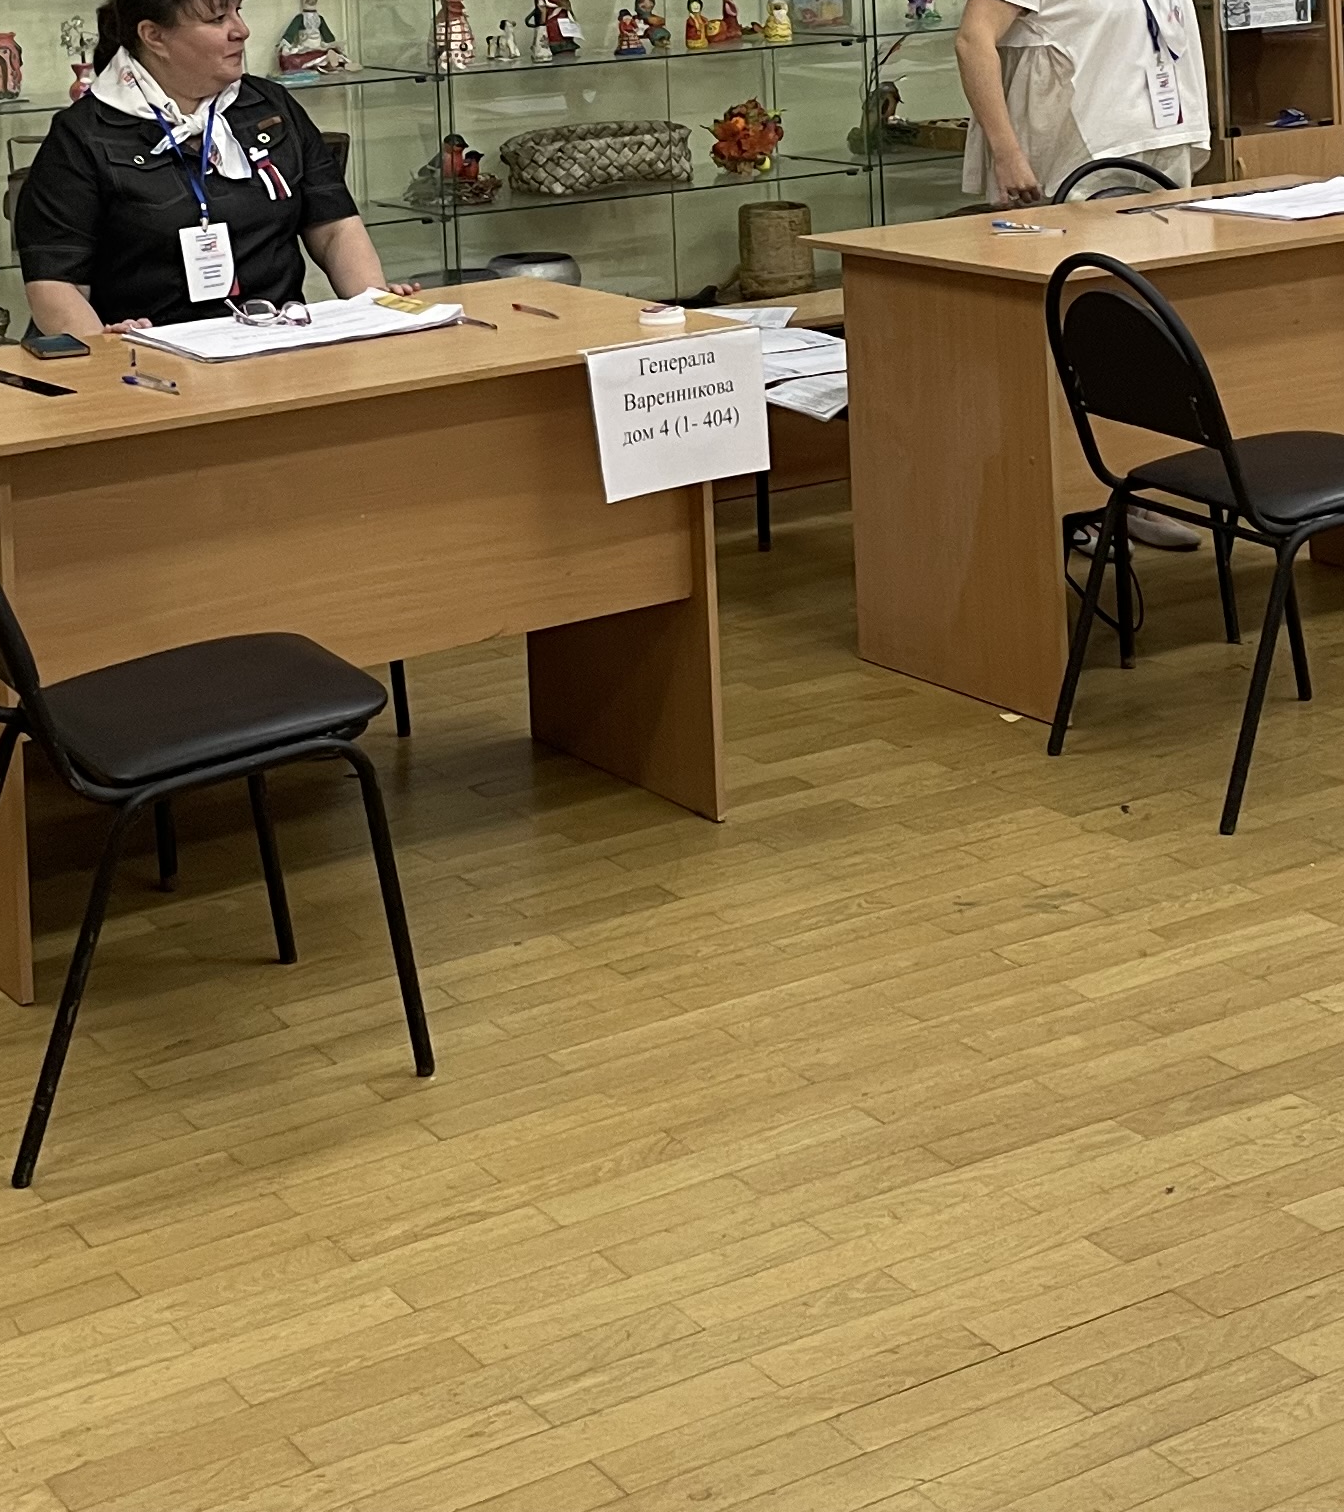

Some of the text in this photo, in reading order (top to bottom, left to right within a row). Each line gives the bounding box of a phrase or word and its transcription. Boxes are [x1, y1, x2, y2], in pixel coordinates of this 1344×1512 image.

[638, 351, 716, 377] Генерала
[623, 379, 735, 413] Варенникова
[622, 427, 655, 448] дом
[659, 418, 670, 437] 4
